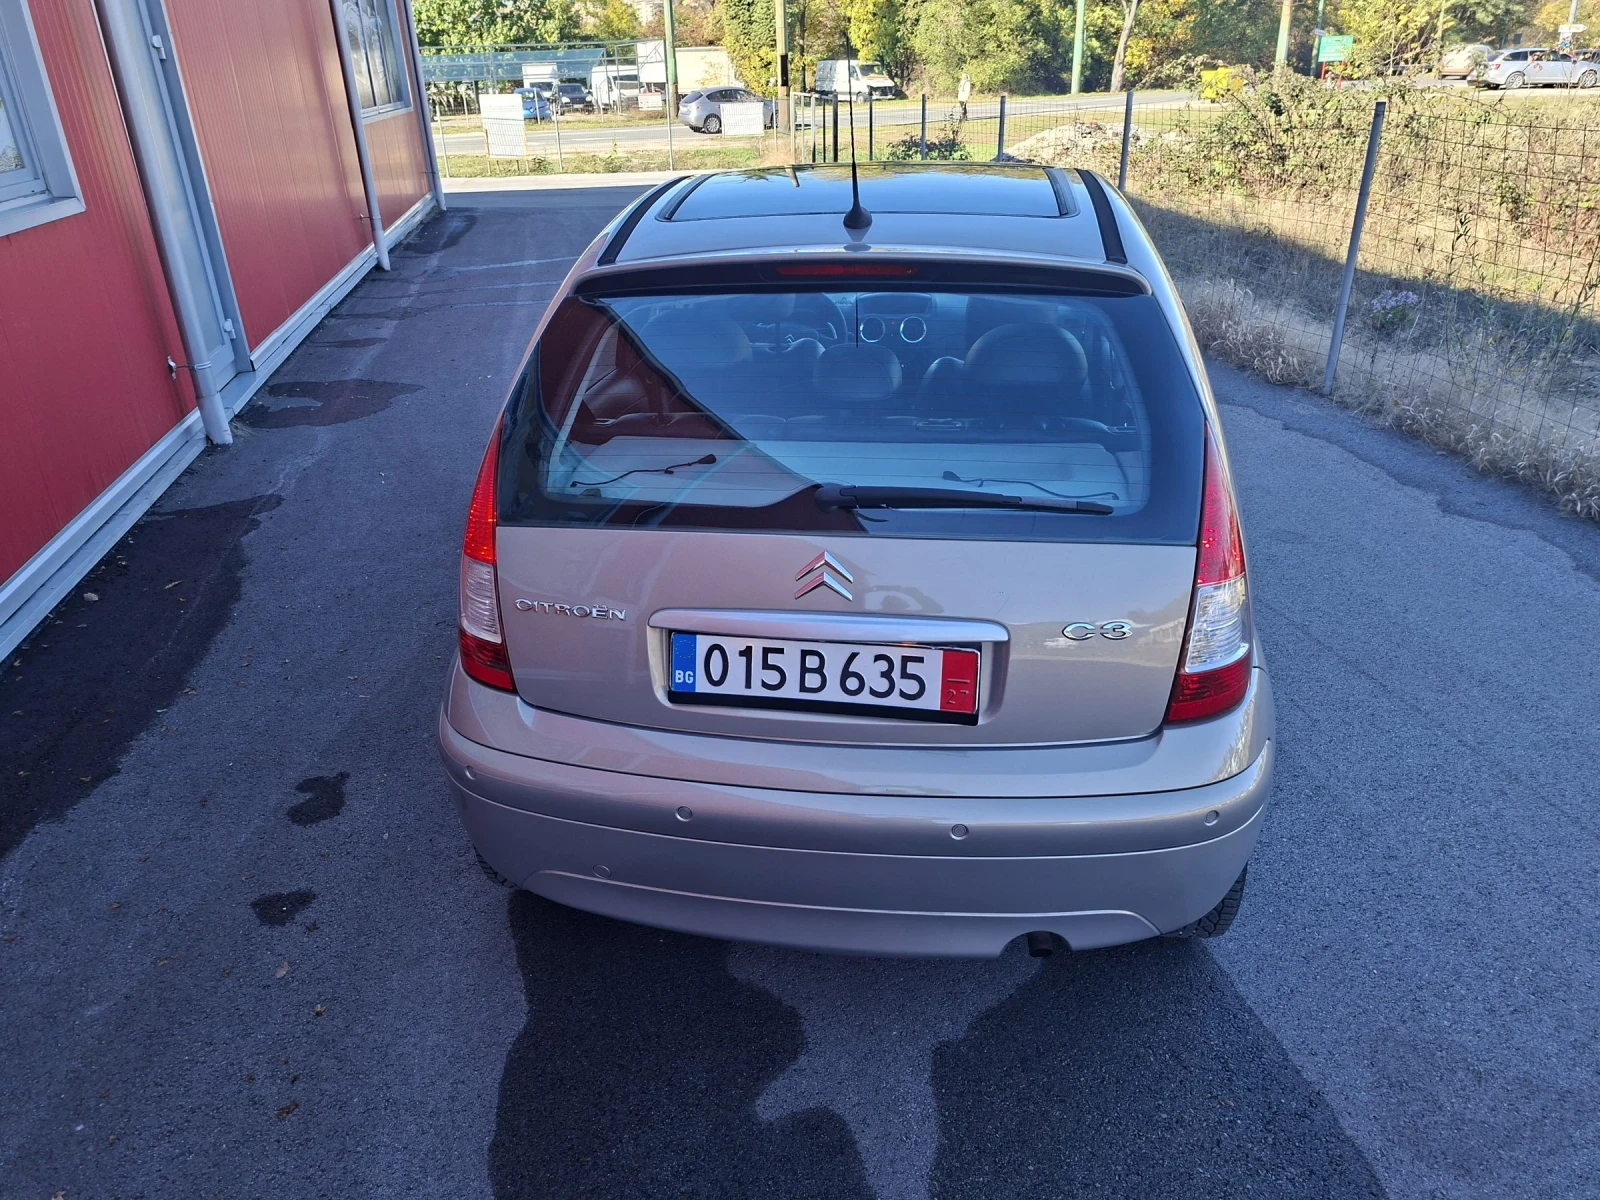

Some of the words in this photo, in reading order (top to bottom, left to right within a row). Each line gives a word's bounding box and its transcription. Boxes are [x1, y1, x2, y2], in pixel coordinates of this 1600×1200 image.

[514, 598, 626, 621] CITROËN
[1061, 620, 1133, 641] C3
[675, 669, 694, 684] BG
